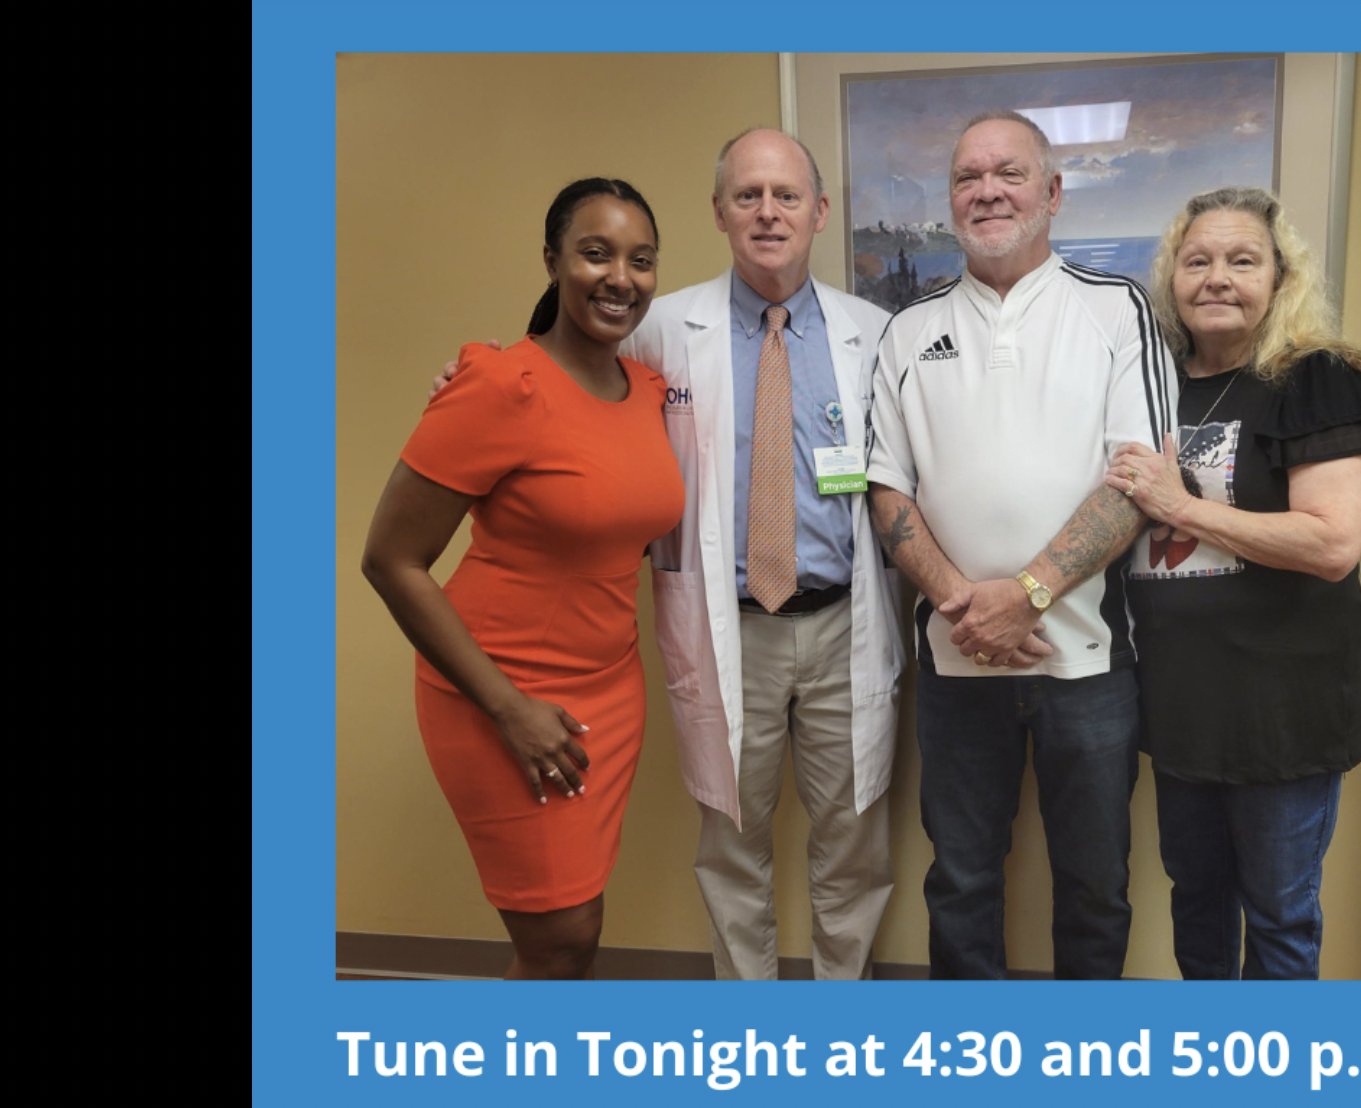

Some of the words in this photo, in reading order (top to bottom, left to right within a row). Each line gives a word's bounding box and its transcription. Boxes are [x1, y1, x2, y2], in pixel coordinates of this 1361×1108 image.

[919, 350, 959, 361] adidas
[666, 387, 693, 405] OH
[823, 480, 864, 491] Physician
